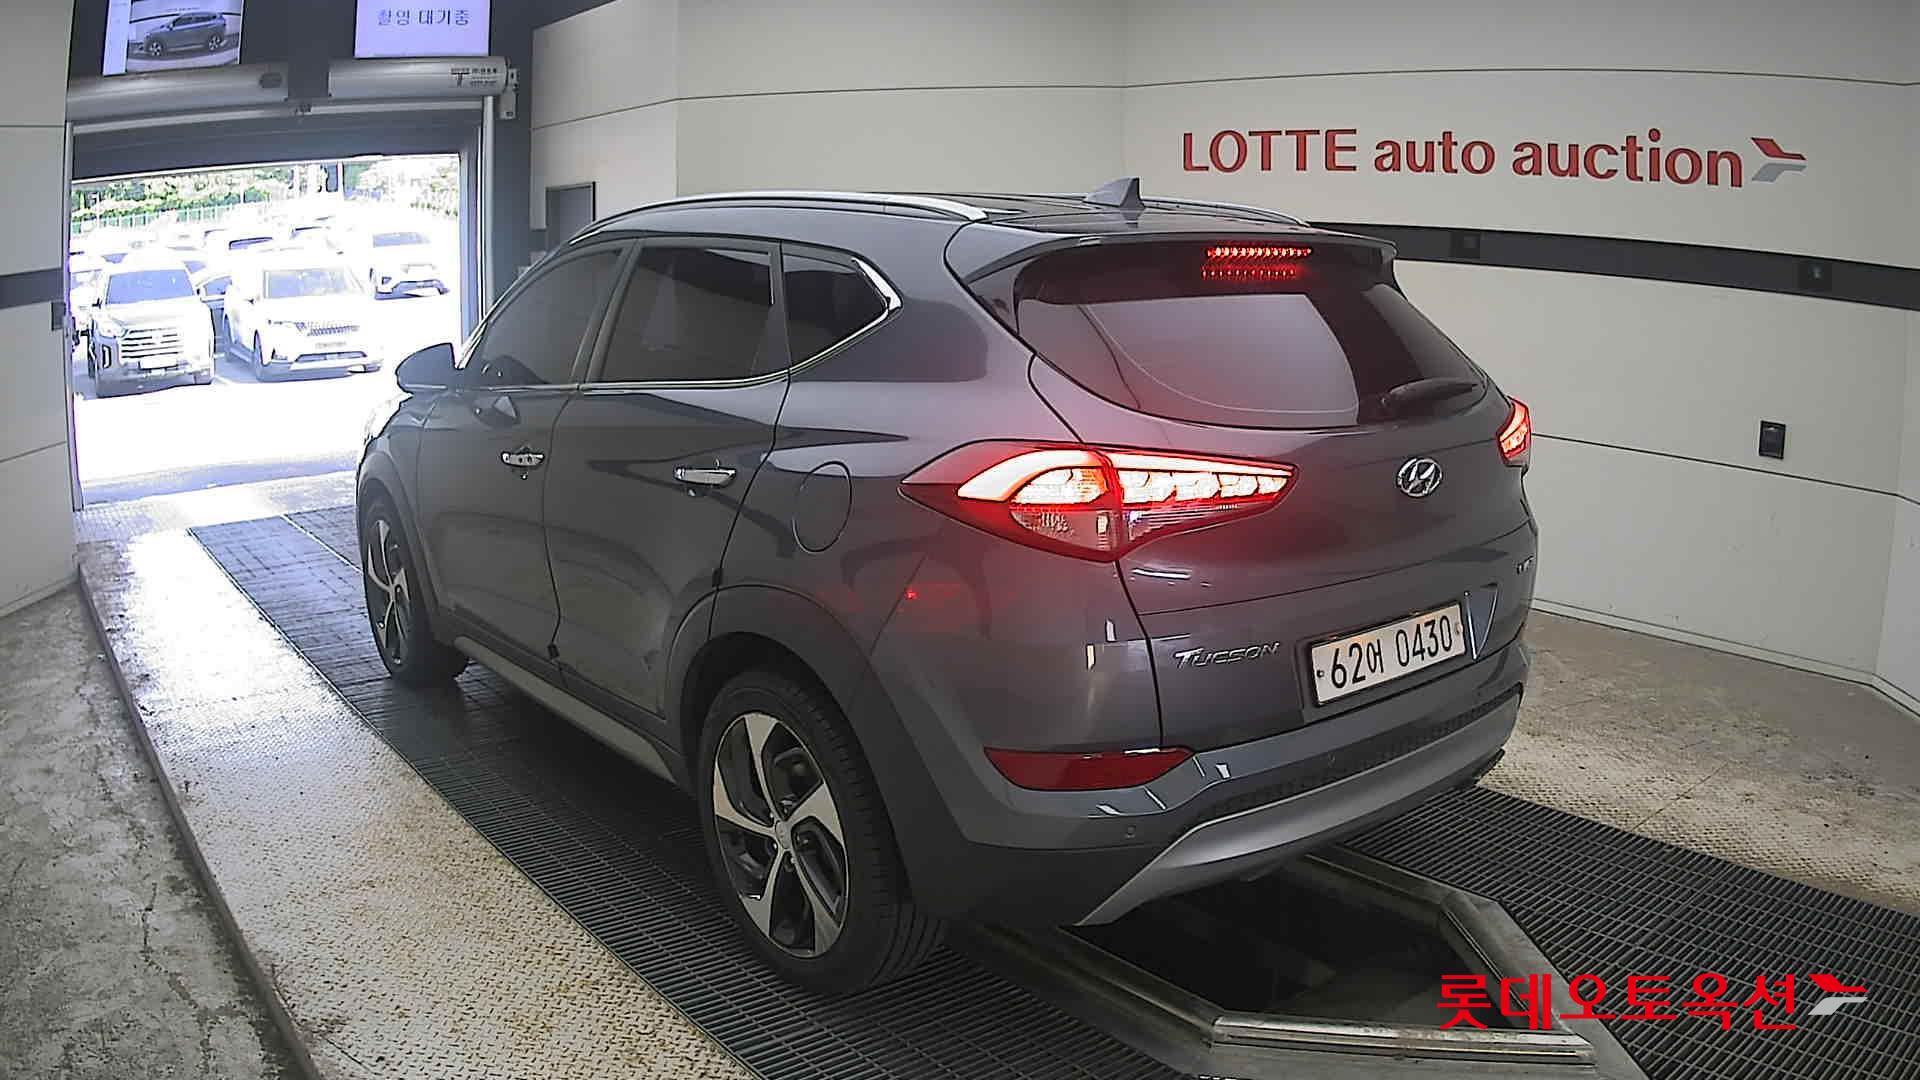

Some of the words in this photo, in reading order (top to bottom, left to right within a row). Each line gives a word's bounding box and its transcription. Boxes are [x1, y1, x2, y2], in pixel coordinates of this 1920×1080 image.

[1183, 128, 1358, 173] LOTTE
[1373, 130, 1497, 175] auto
[1512, 127, 1744, 189] auction
[1174, 641, 1280, 669] TUCSON
[1331, 638, 1384, 689] 62어
[1395, 615, 1453, 667] 0430
